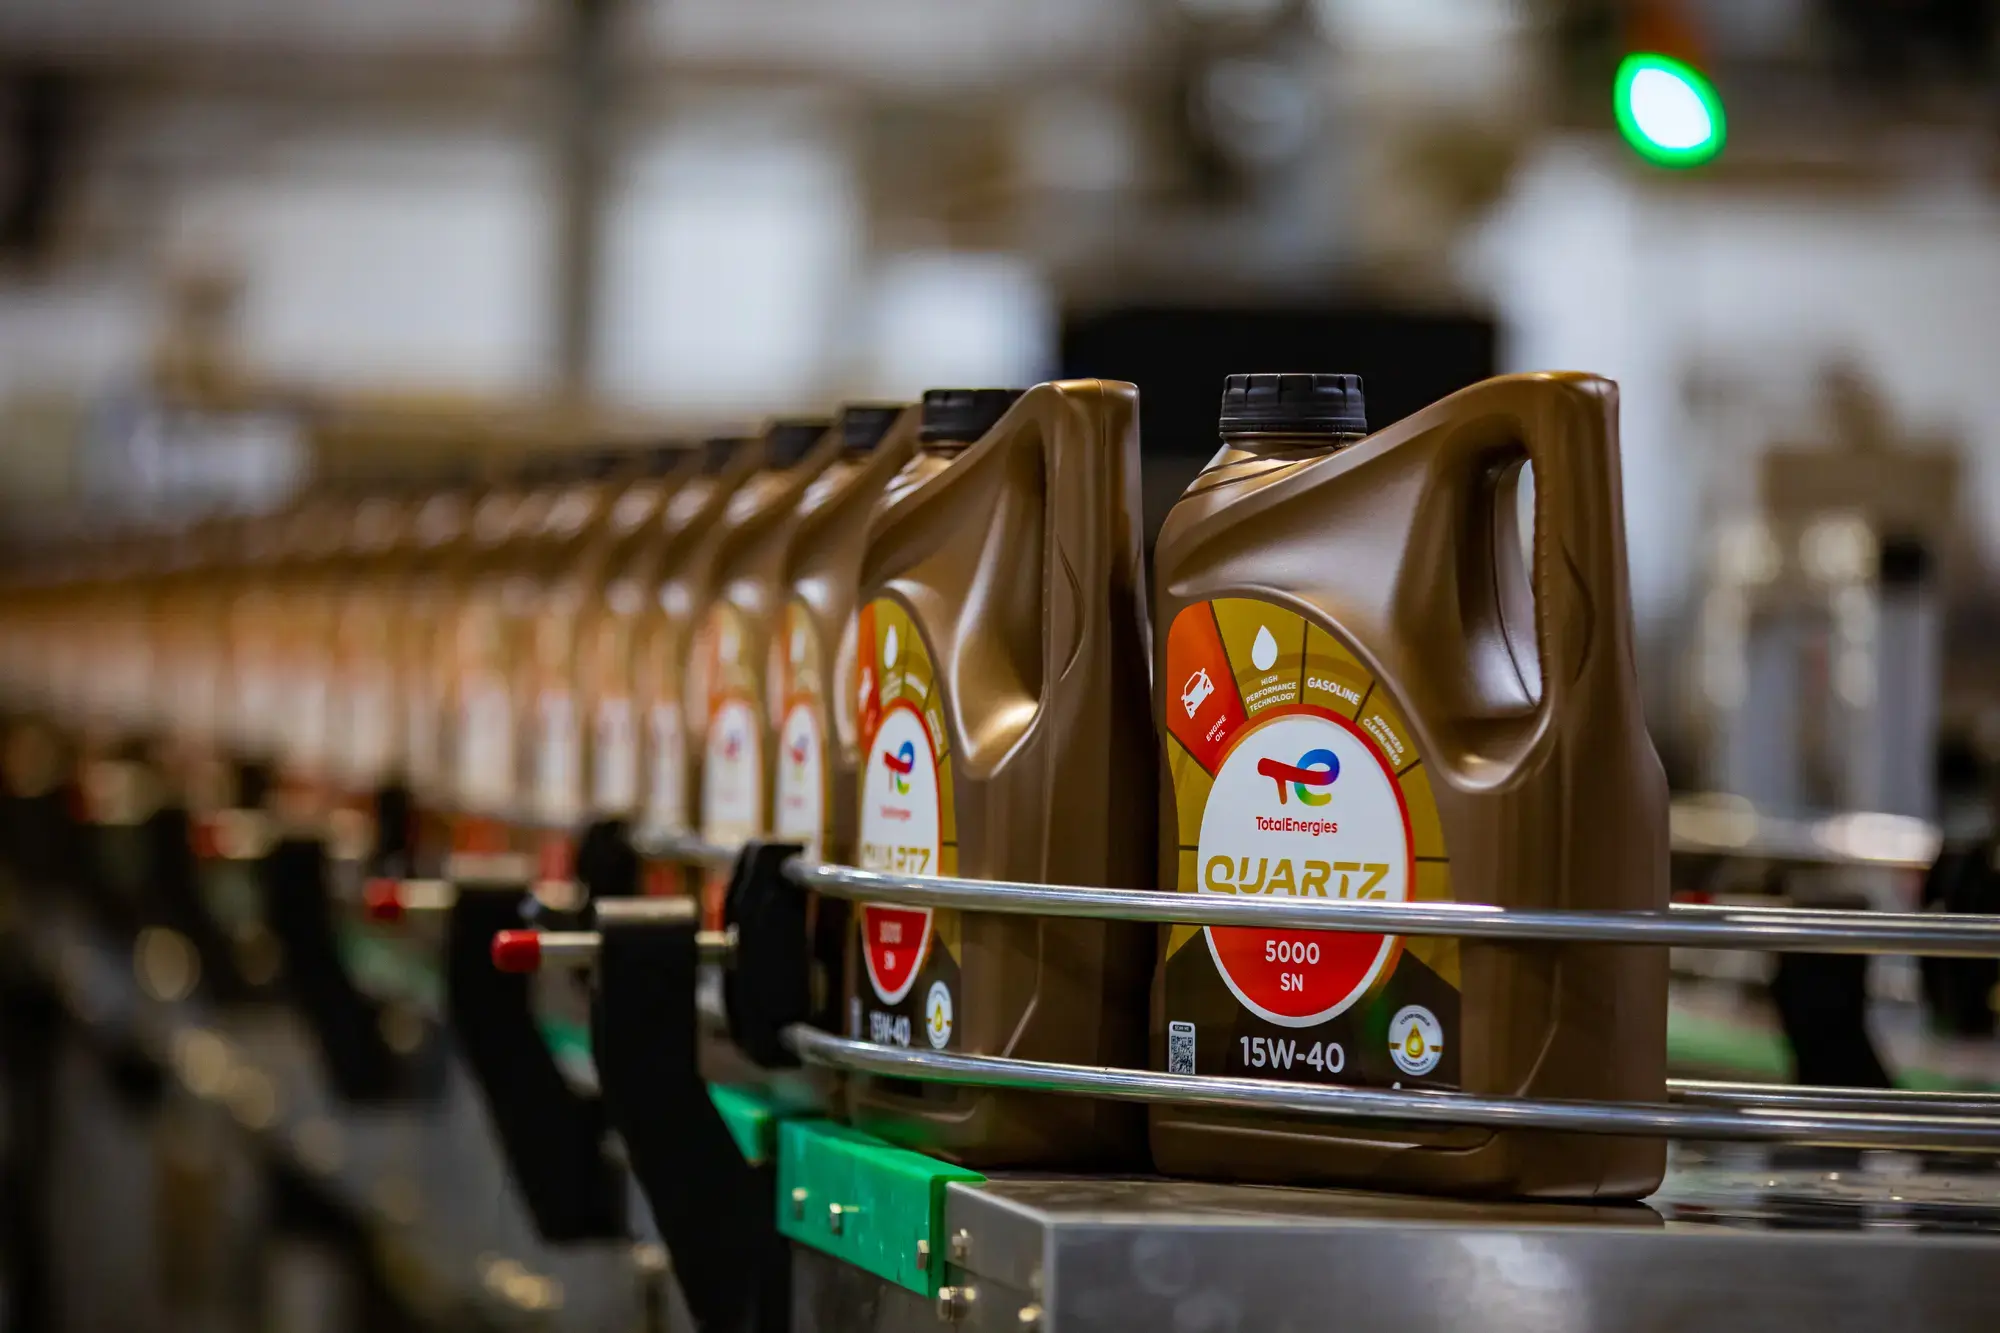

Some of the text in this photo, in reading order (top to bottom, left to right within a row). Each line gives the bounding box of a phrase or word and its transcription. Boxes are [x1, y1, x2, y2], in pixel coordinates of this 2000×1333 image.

[1261, 675, 1278, 686] HIGH
[1307, 676, 1361, 706] GASOLINE
[1246, 682, 1297, 704] PERFORMANCE
[1250, 692, 1296, 712] TECHNOLOGY
[1205, 714, 1227, 742] ENGINE
[1215, 729, 1226, 742] OIL
[1372, 715, 1404, 753] ADVANCED
[1255, 816, 1338, 836] TotalEnergies
[1204, 854, 1390, 900] QUARTZ
[1264, 939, 1320, 965] 5000
[1280, 972, 1304, 992] SN
[1239, 1035, 1345, 1074] 15W-40
